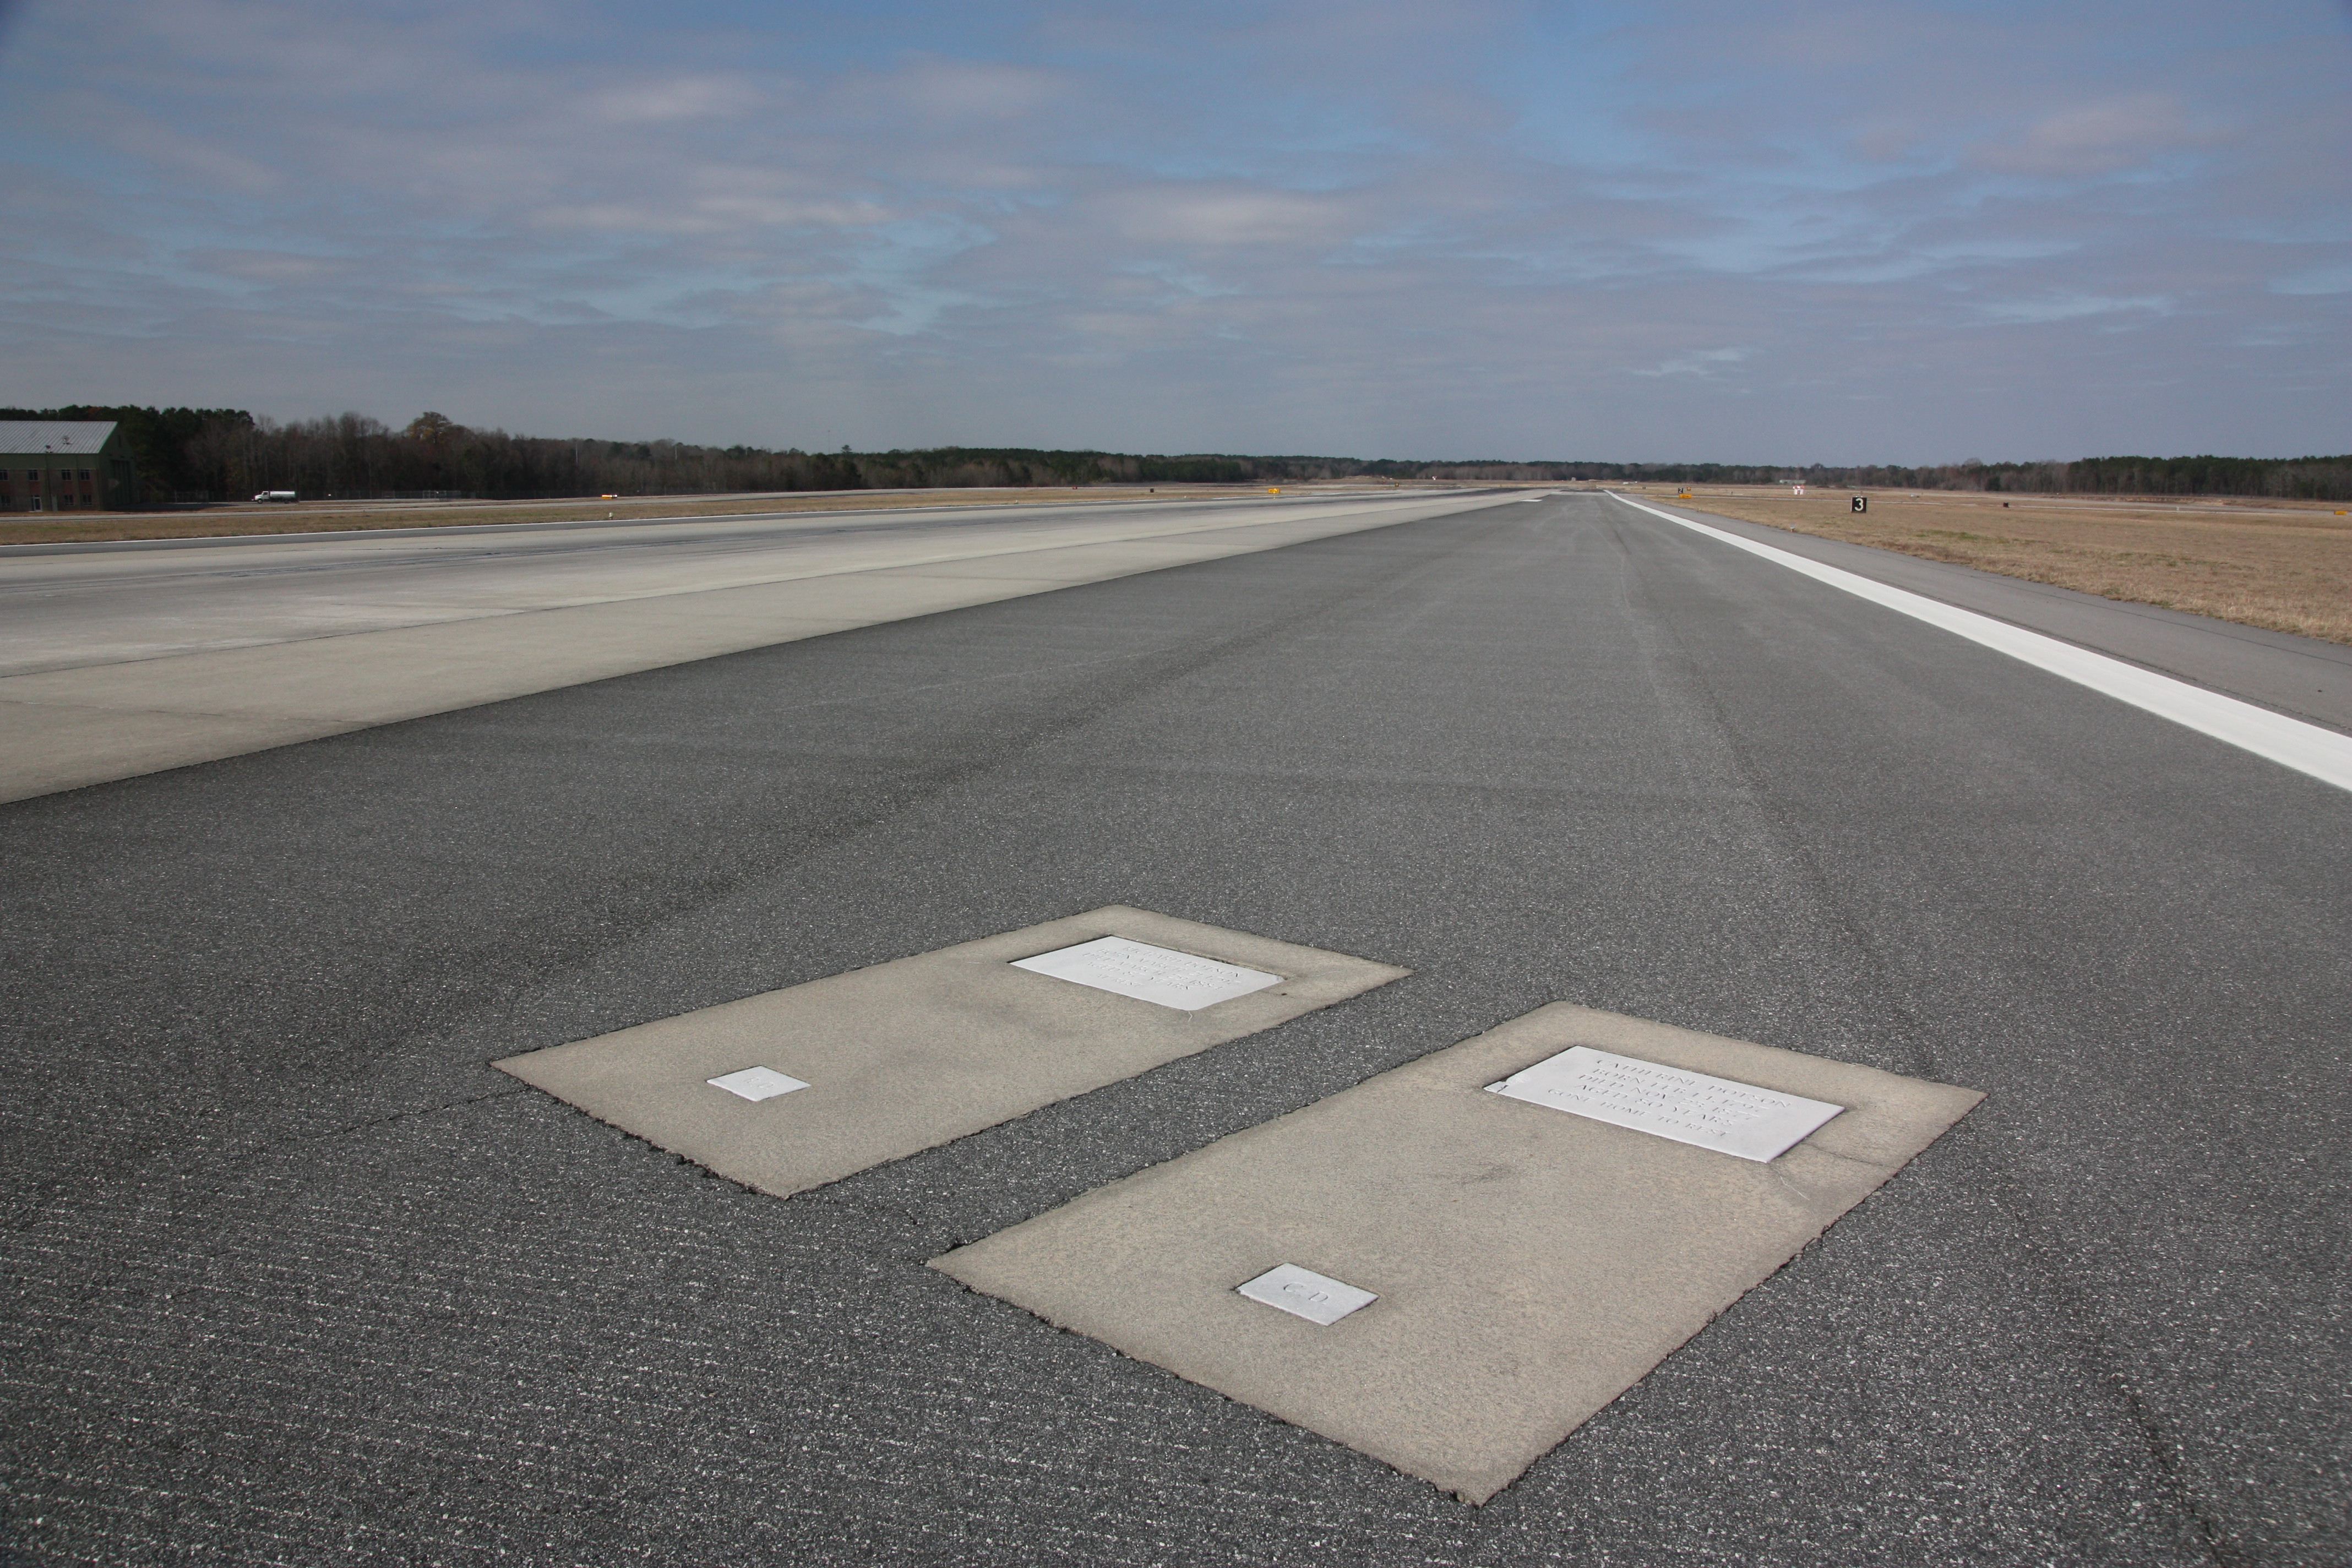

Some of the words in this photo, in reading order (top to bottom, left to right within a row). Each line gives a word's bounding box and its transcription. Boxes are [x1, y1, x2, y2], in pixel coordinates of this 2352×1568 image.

[1855, 498, 1863, 511] 3
[1082, 952, 1116, 961] DIED
[1118, 961, 1166, 975] MARCH
[1087, 961, 1121, 971] AGED
[1145, 976, 1194, 990] YEARS
[1097, 948, 1136, 959] BORN
[1138, 958, 1188, 972] MARCH
[1122, 946, 1183, 962] RICHARD
[1184, 961, 1244, 978] DOTSON
[1112, 977, 1145, 987] REST
[1578, 1074, 1625, 1088] DIED
[1712, 1107, 1760, 1120] 1877
[1592, 1068, 1646, 1084] BORN
[1722, 1099, 1770, 1112] 1797
[1596, 1059, 1703, 1086] CATHERINE
[1708, 1085, 1793, 1108] DOTSON
[1548, 1088, 1596, 1102] GONE
[1599, 1101, 1651, 1117] HOME
[1657, 1114, 1680, 1124] TO
[1685, 1123, 1733, 1136] REST
[1574, 1084, 1628, 1099] AGED
[1635, 1098, 1663, 1108] 80
[1672, 1106, 1737, 1126] YEARS
